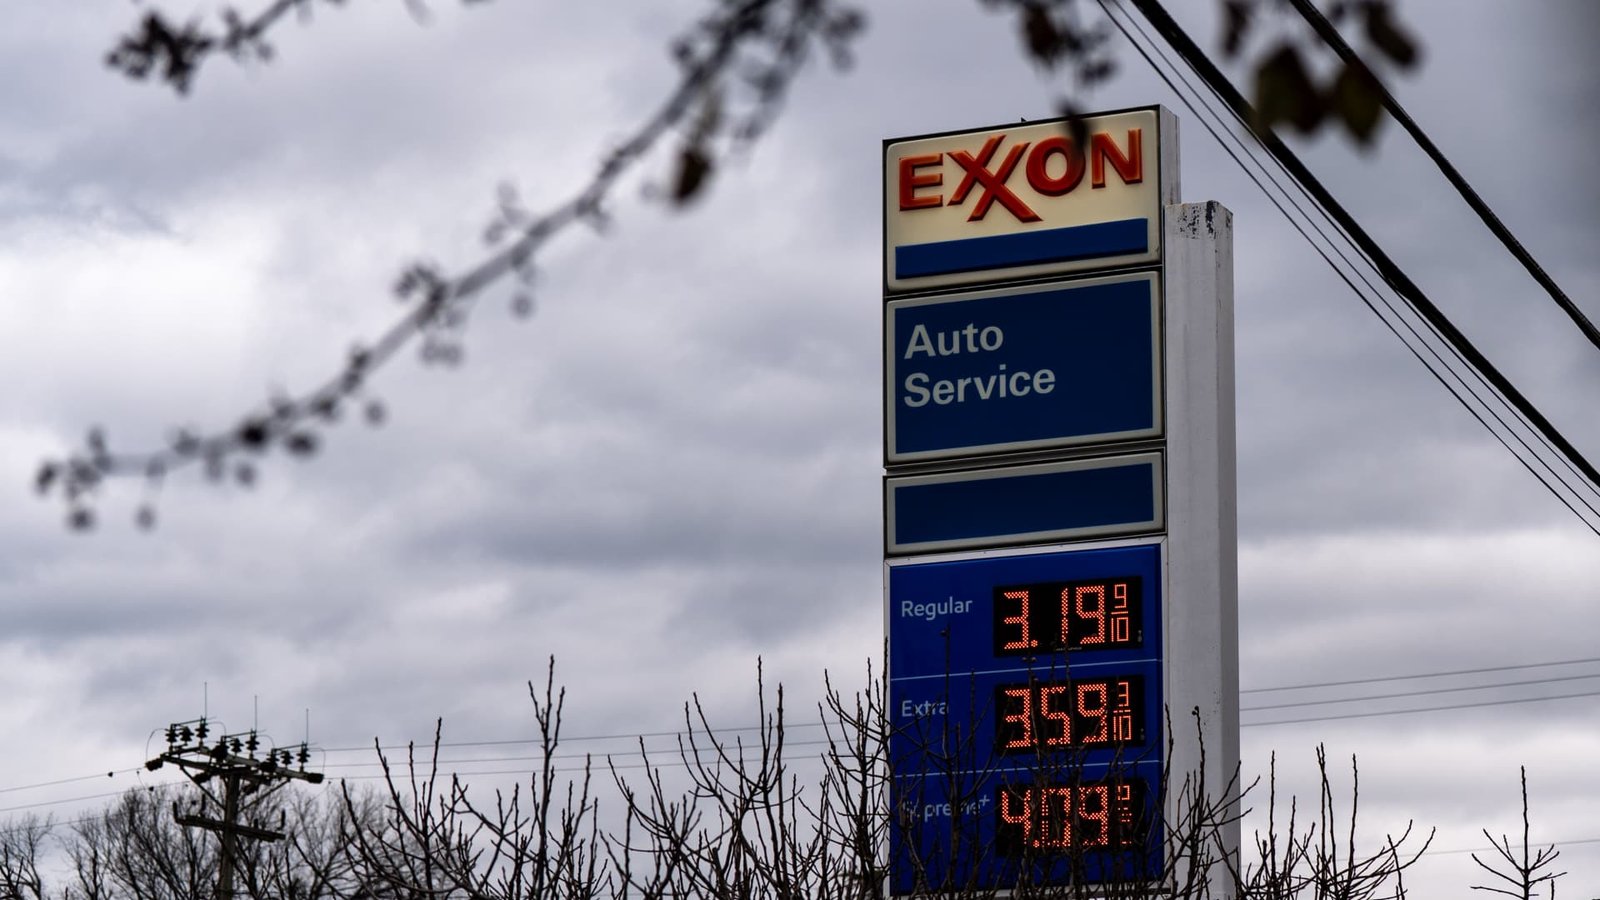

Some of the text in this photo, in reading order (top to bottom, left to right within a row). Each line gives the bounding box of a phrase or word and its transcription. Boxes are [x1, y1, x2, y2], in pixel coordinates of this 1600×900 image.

[899, 128, 1143, 223] EXXON
[904, 322, 1004, 360] Auto
[904, 364, 1056, 408] Service
[901, 596, 973, 621] Regular
[1004, 585, 1105, 649] 3.19
[902, 700, 949, 717] Extra
[1002, 786, 1108, 848] 4.09
